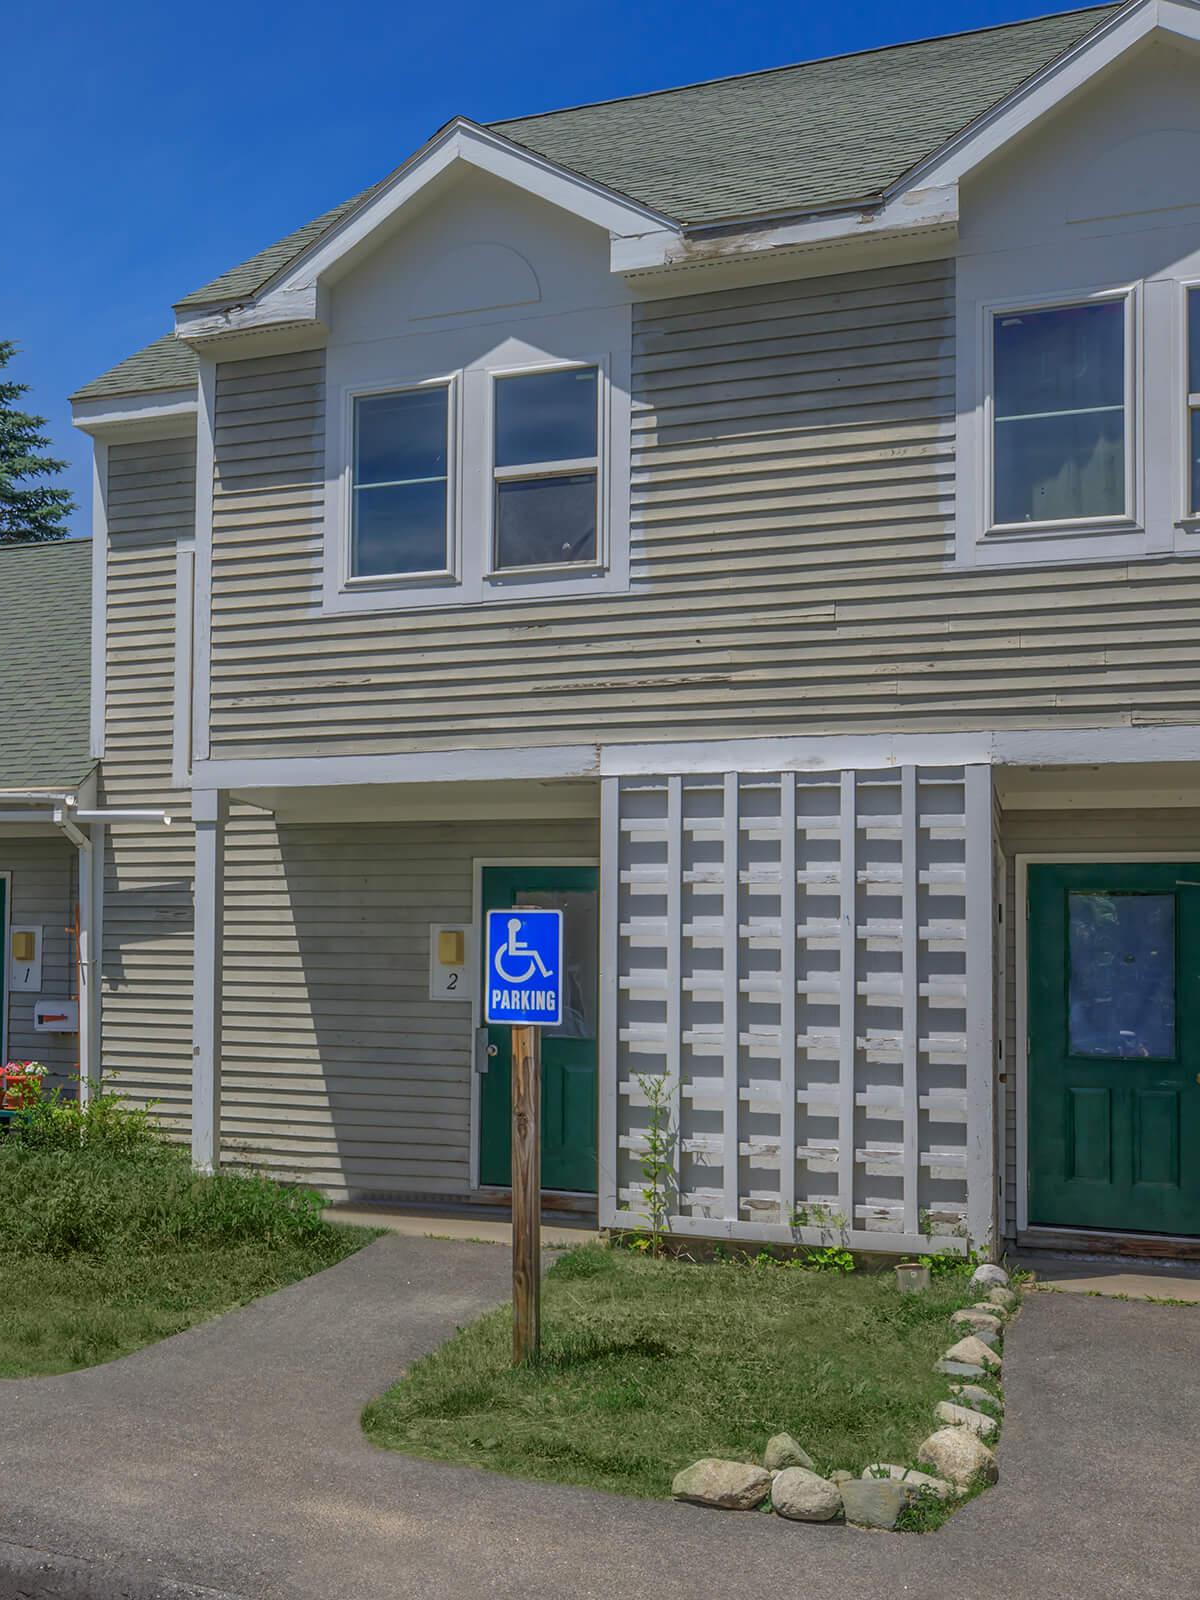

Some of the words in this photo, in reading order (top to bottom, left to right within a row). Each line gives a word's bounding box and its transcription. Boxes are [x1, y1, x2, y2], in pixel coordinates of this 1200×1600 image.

[24, 967, 30, 983] 1
[446, 973, 458, 990] 2
[492, 989, 556, 1011] PARKING
